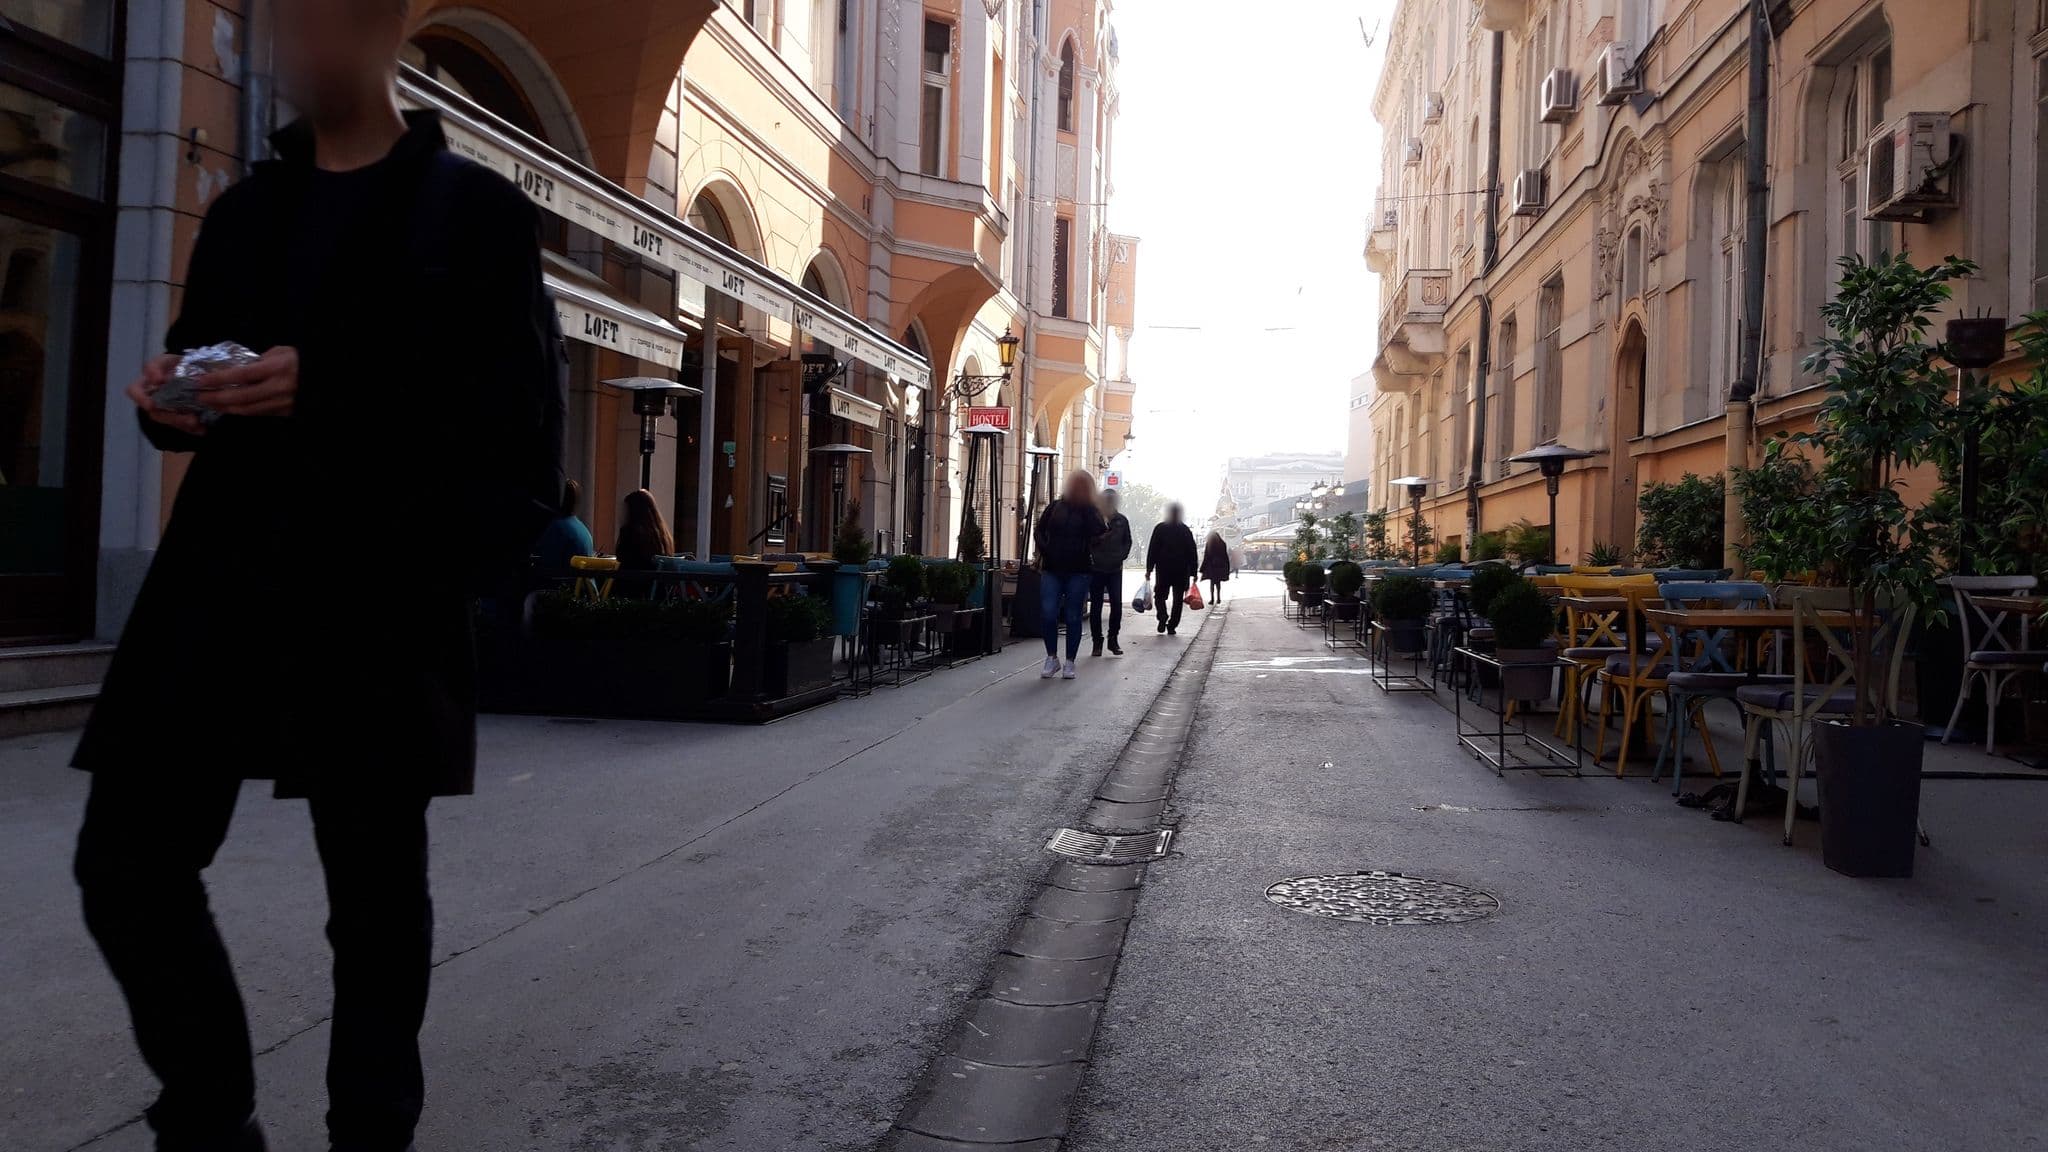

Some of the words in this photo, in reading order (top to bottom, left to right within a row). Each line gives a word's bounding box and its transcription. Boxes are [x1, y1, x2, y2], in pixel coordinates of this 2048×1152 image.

[514, 162, 554, 202] LOFT
[633, 225, 663, 256] LOFT
[722, 270, 746, 296] LOFT
[584, 313, 619, 343] LOFT
[797, 308, 813, 330] LOFT
[845, 333, 859, 354] LOFT
[884, 354, 896, 371] LOFT
[972, 414, 1007, 426] HOSTEL
